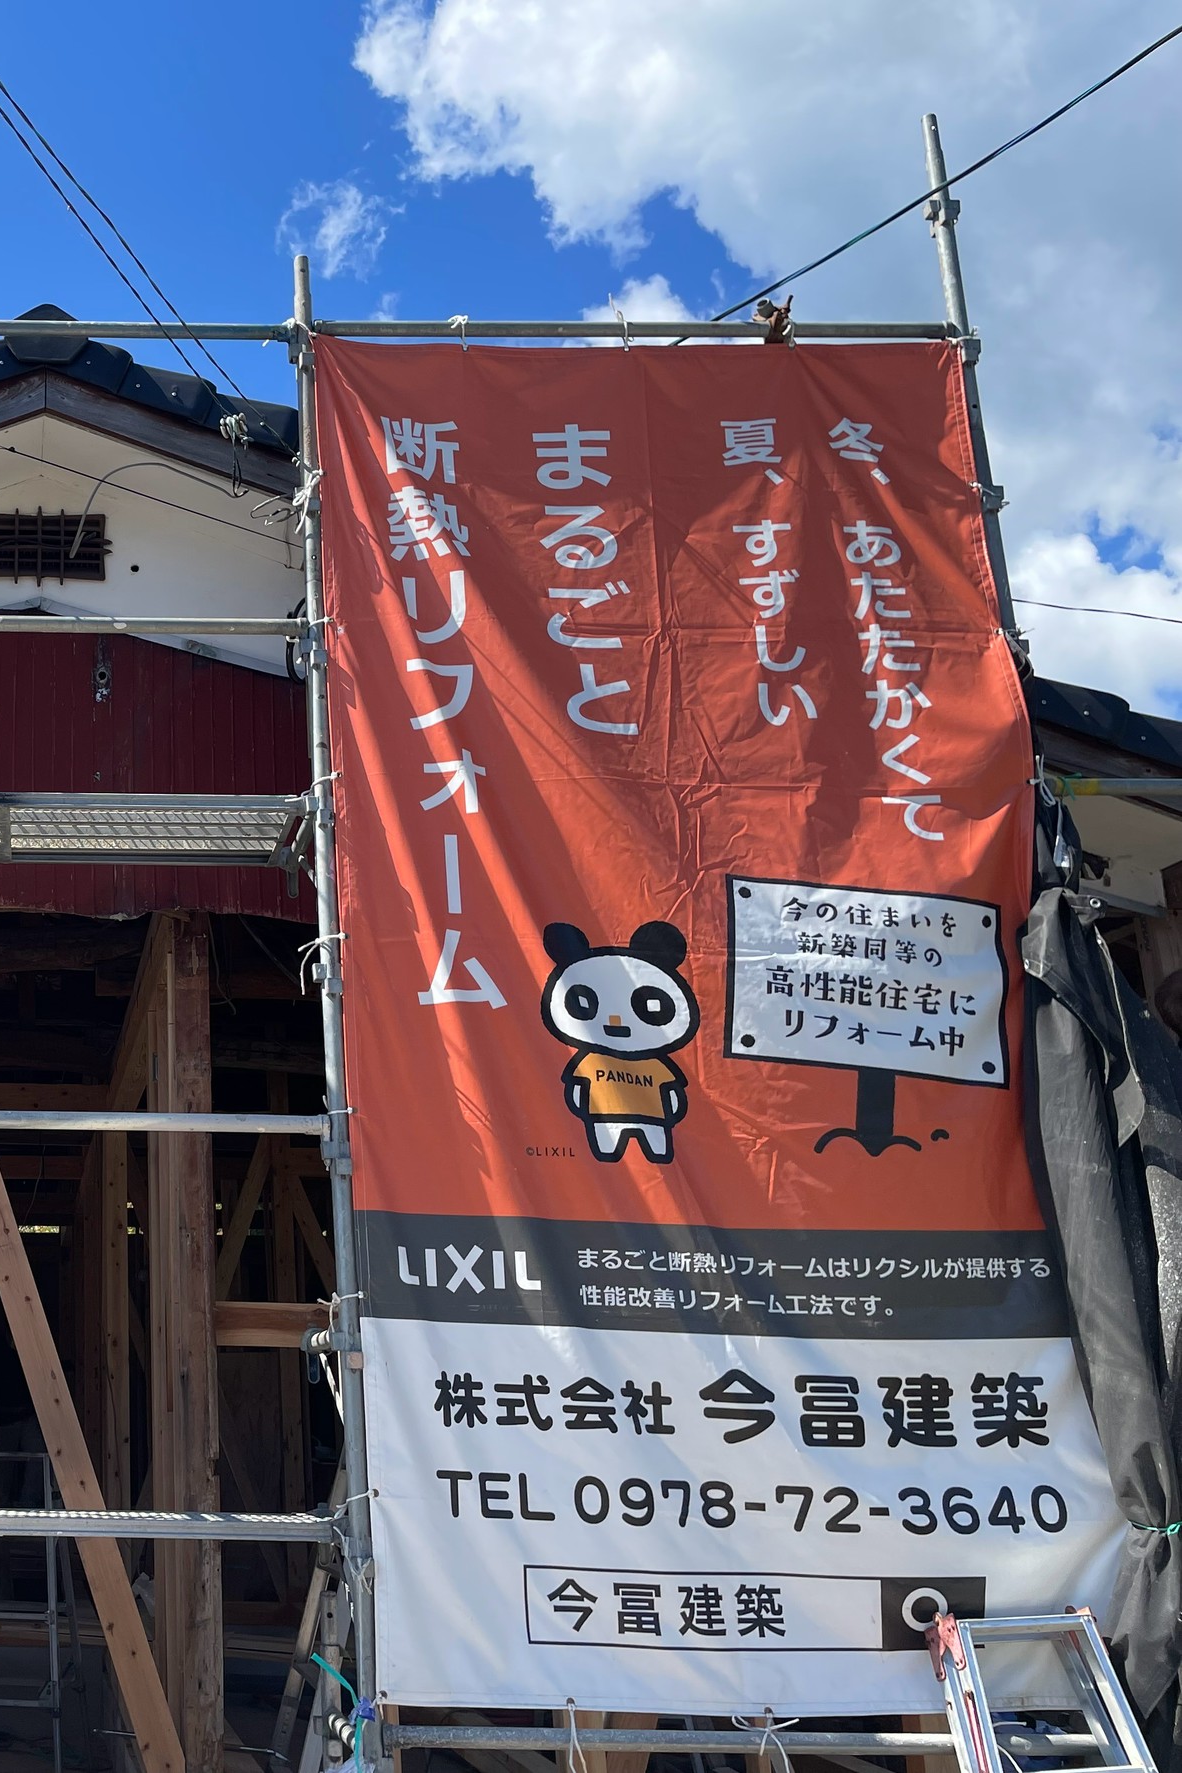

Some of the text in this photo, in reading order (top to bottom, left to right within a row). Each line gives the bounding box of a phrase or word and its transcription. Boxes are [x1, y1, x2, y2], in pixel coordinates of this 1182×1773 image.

[532, 423, 639, 738] まるごと
[720, 417, 818, 727] 夏、すずしい
[827, 416, 944, 842] 冬、あたたかくて
[380, 416, 507, 1010] 断熱リフォーム
[781, 896, 959, 939] 今の住まいを
[796, 931, 943, 968] 新築同等の
[765, 964, 977, 1018] 高性能住宅に
[784, 1008, 966, 1058] リフォーム中
[595, 1069, 654, 1088] PANDAN
[397, 1244, 542, 1294] LIXIL
[577, 1248, 1052, 1279] まるごと断熱リフォームはリクシルが提供する
[579, 1285, 896, 1317] 性能改善リフォーム工法です。
[434, 1370, 676, 1436] 株式会社
[435, 1469, 1068, 1536] TEL 0978-72-3640
